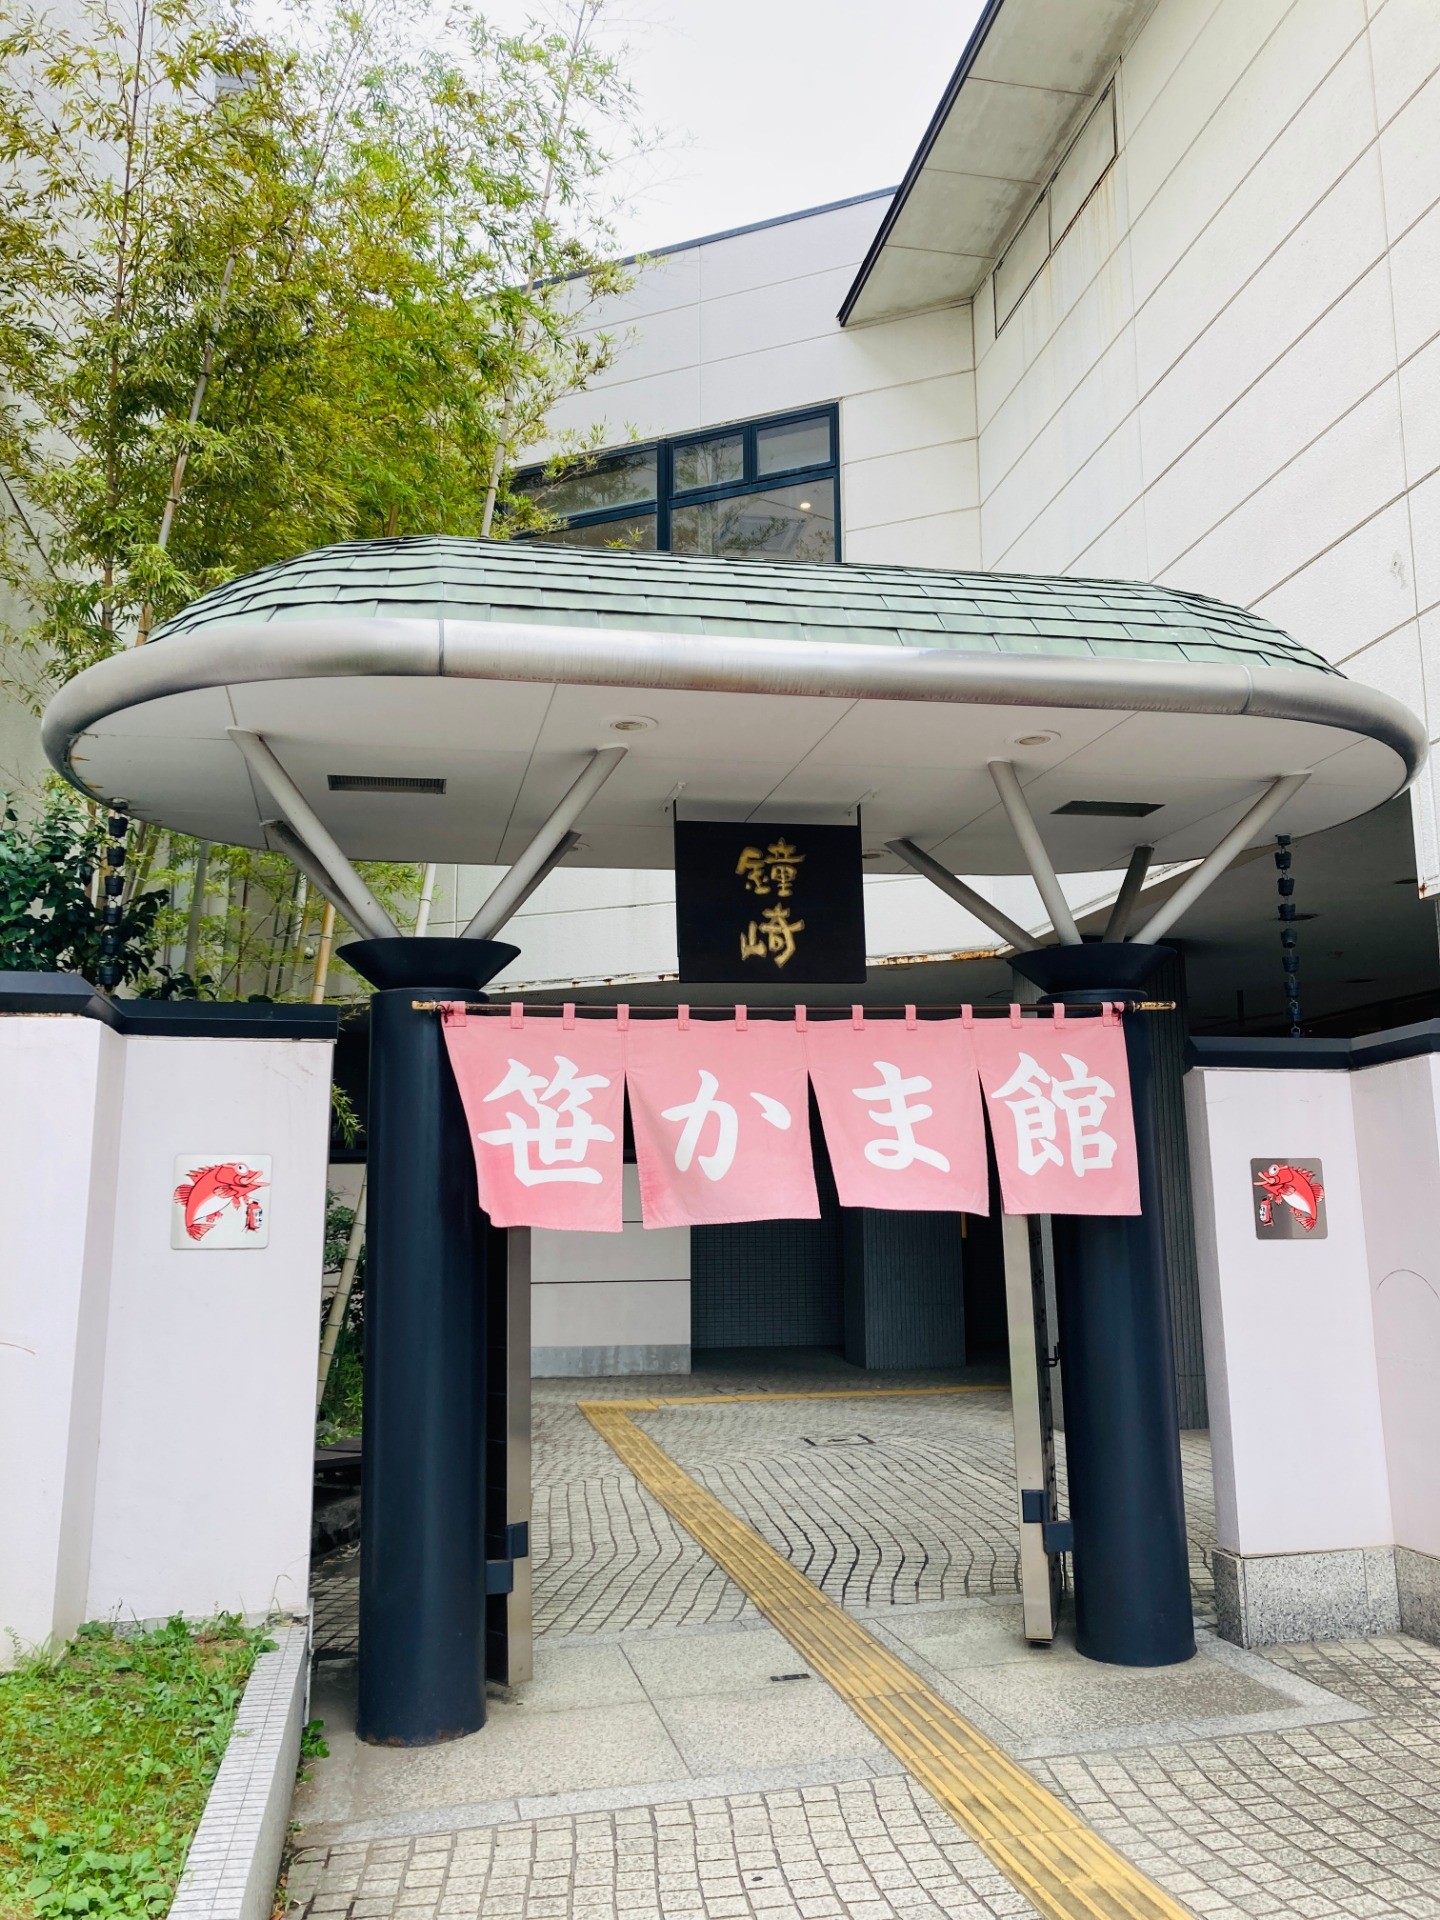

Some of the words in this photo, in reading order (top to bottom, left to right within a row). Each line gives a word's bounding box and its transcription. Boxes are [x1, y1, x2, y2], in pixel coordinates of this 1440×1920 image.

[735, 836, 807, 969] 鐘崎
[478, 1052, 1118, 1187] 笹かま館
